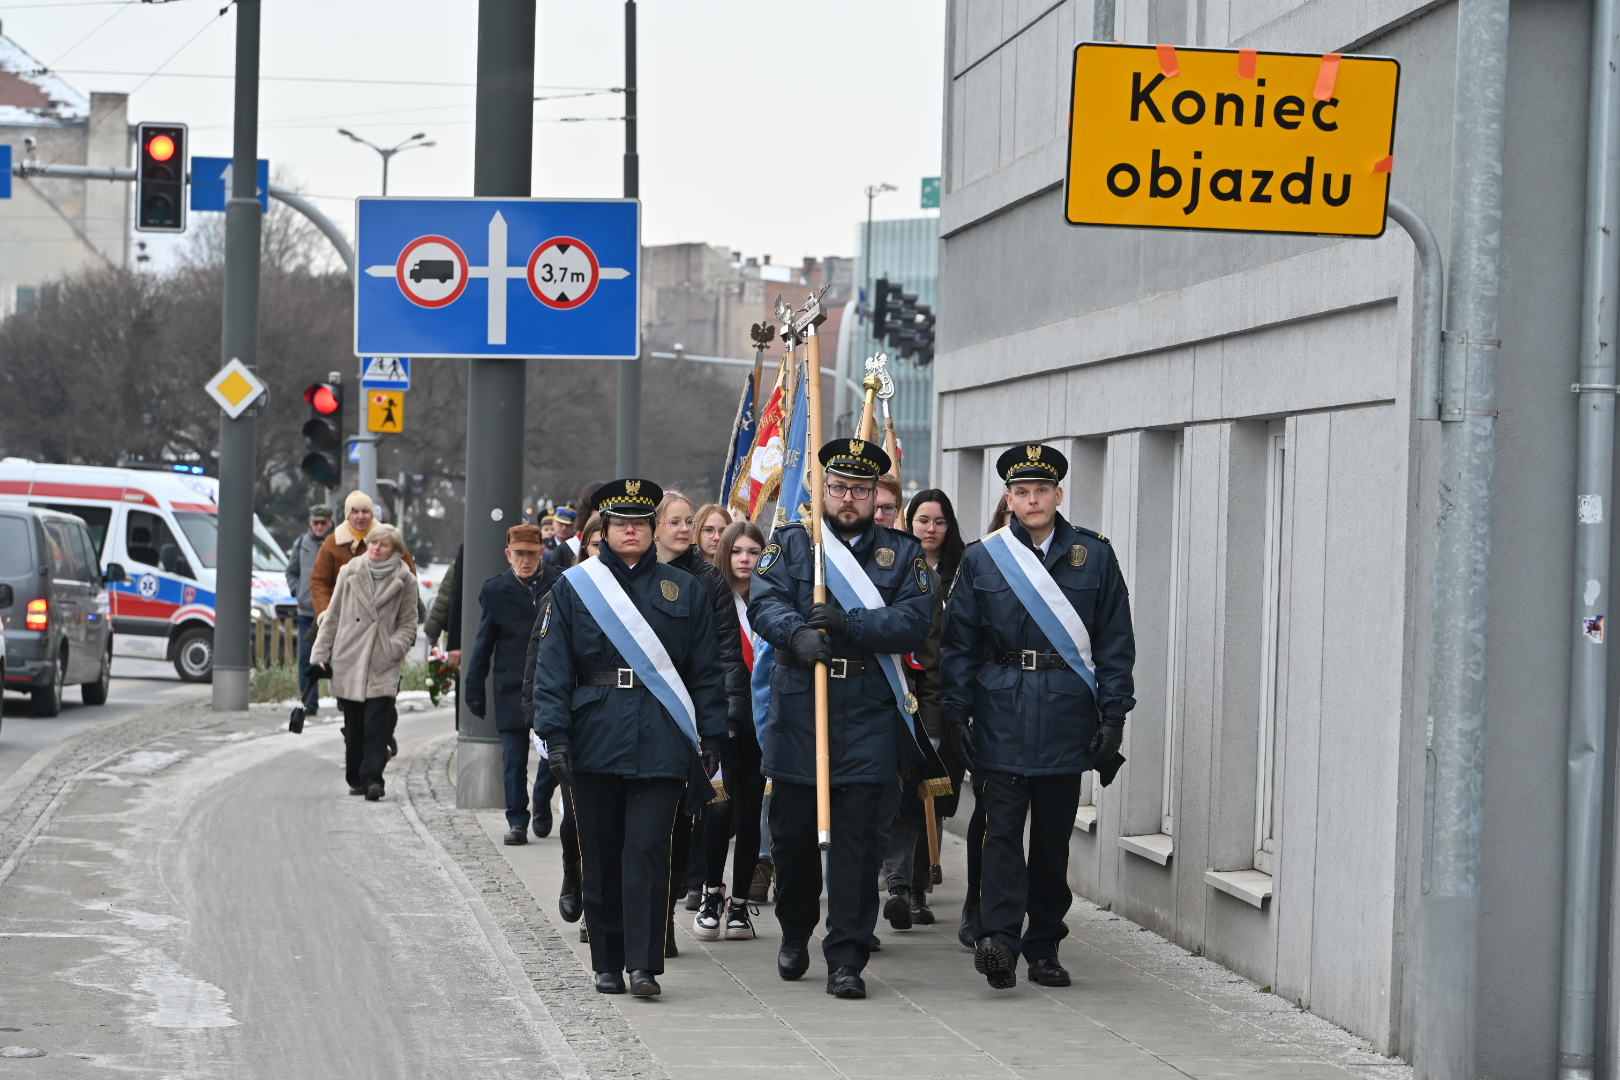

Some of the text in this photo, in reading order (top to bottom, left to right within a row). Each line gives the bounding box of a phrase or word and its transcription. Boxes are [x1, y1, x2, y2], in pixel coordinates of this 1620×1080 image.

[1130, 72, 1340, 132] Koniec
[1106, 149, 1351, 216] objazdu
[761, 410, 780, 429] 1945
